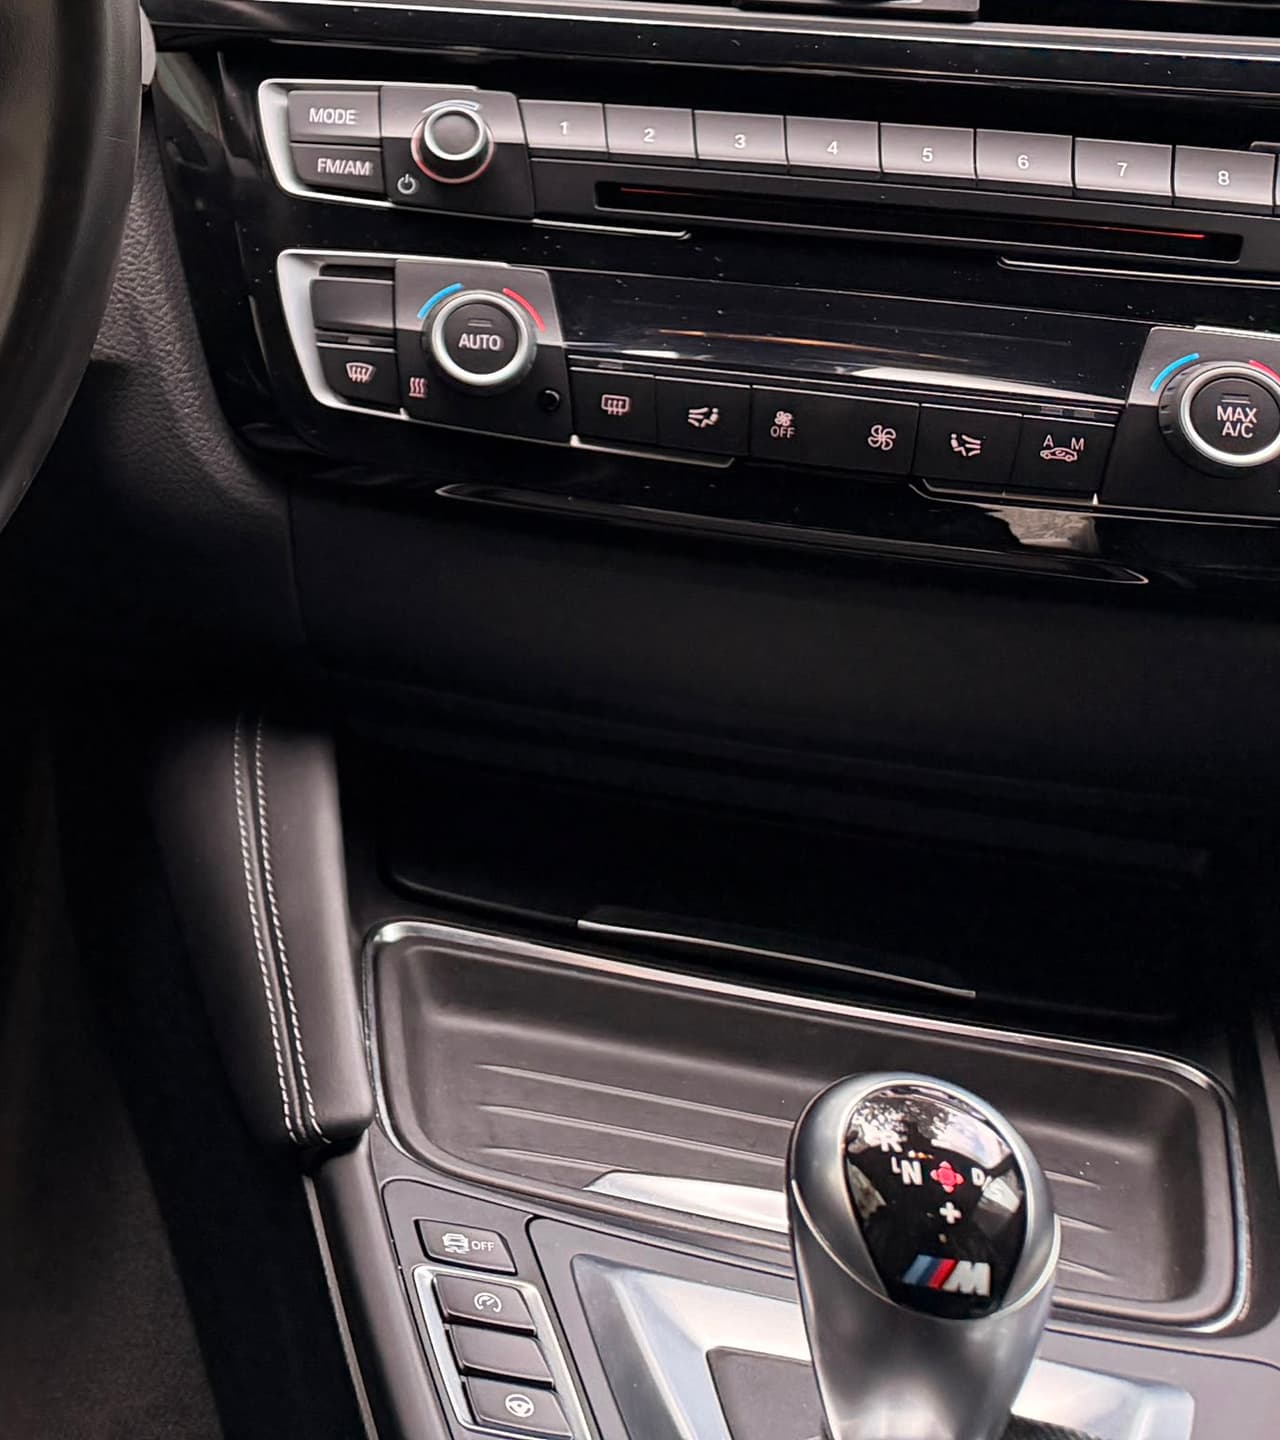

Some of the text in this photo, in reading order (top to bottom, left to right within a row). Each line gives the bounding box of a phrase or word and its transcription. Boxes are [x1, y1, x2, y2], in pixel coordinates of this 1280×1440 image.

[308, 106, 356, 126] MODE
[558, 121, 569, 136] 1
[643, 127, 656, 143] 2
[733, 134, 746, 150] 3
[826, 140, 839, 156] 4
[922, 146, 933, 163] 5
[1017, 154, 1029, 170] 6
[316, 157, 371, 177] FM/AM
[1117, 162, 1128, 178] 7
[1218, 170, 1230, 187] 8
[458, 333, 501, 351] AUTO
[1216, 405, 1257, 424] MAX
[770, 425, 796, 439] OFF
[1221, 421, 1254, 440] A/C
[1043, 435, 1054, 449] A
[1071, 437, 1085, 451] M
[901, 1160, 924, 1186] N
[471, 1240, 495, 1252] OFF
